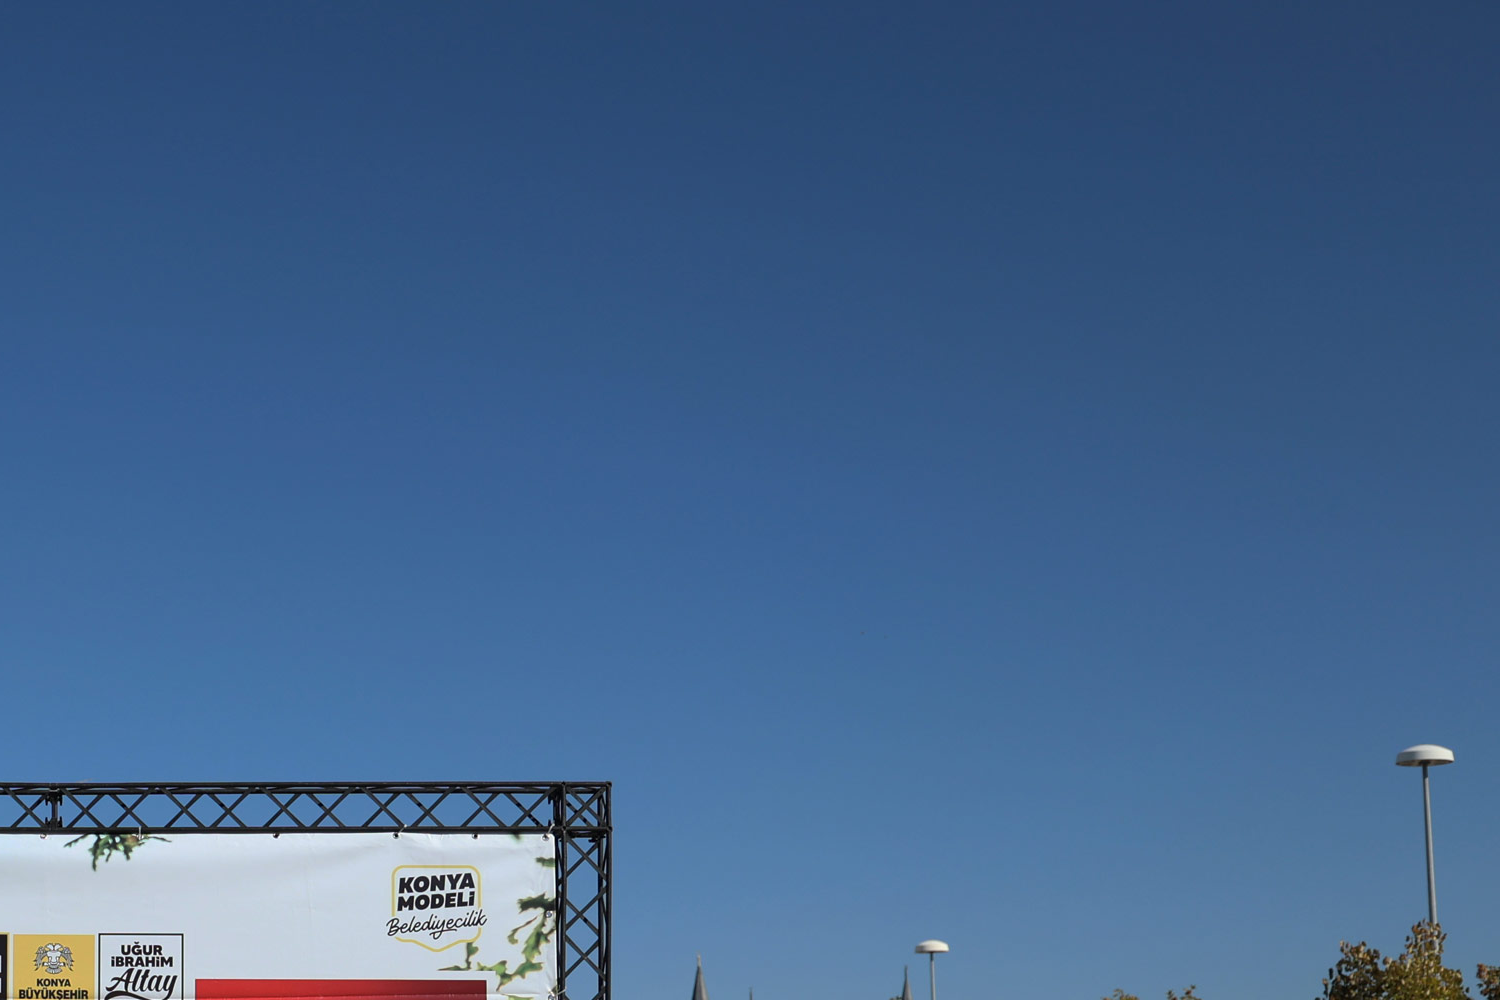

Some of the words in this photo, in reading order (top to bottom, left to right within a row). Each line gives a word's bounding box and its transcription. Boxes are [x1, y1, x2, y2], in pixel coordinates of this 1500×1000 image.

[399, 873, 475, 894] KONYA
[386, 909, 487, 940] Belediyecilik
[121, 942, 163, 956] UĞUR
[37, 978, 71, 987] KONYA
[19, 987, 89, 1000] BÜYÜKŞEHİR
